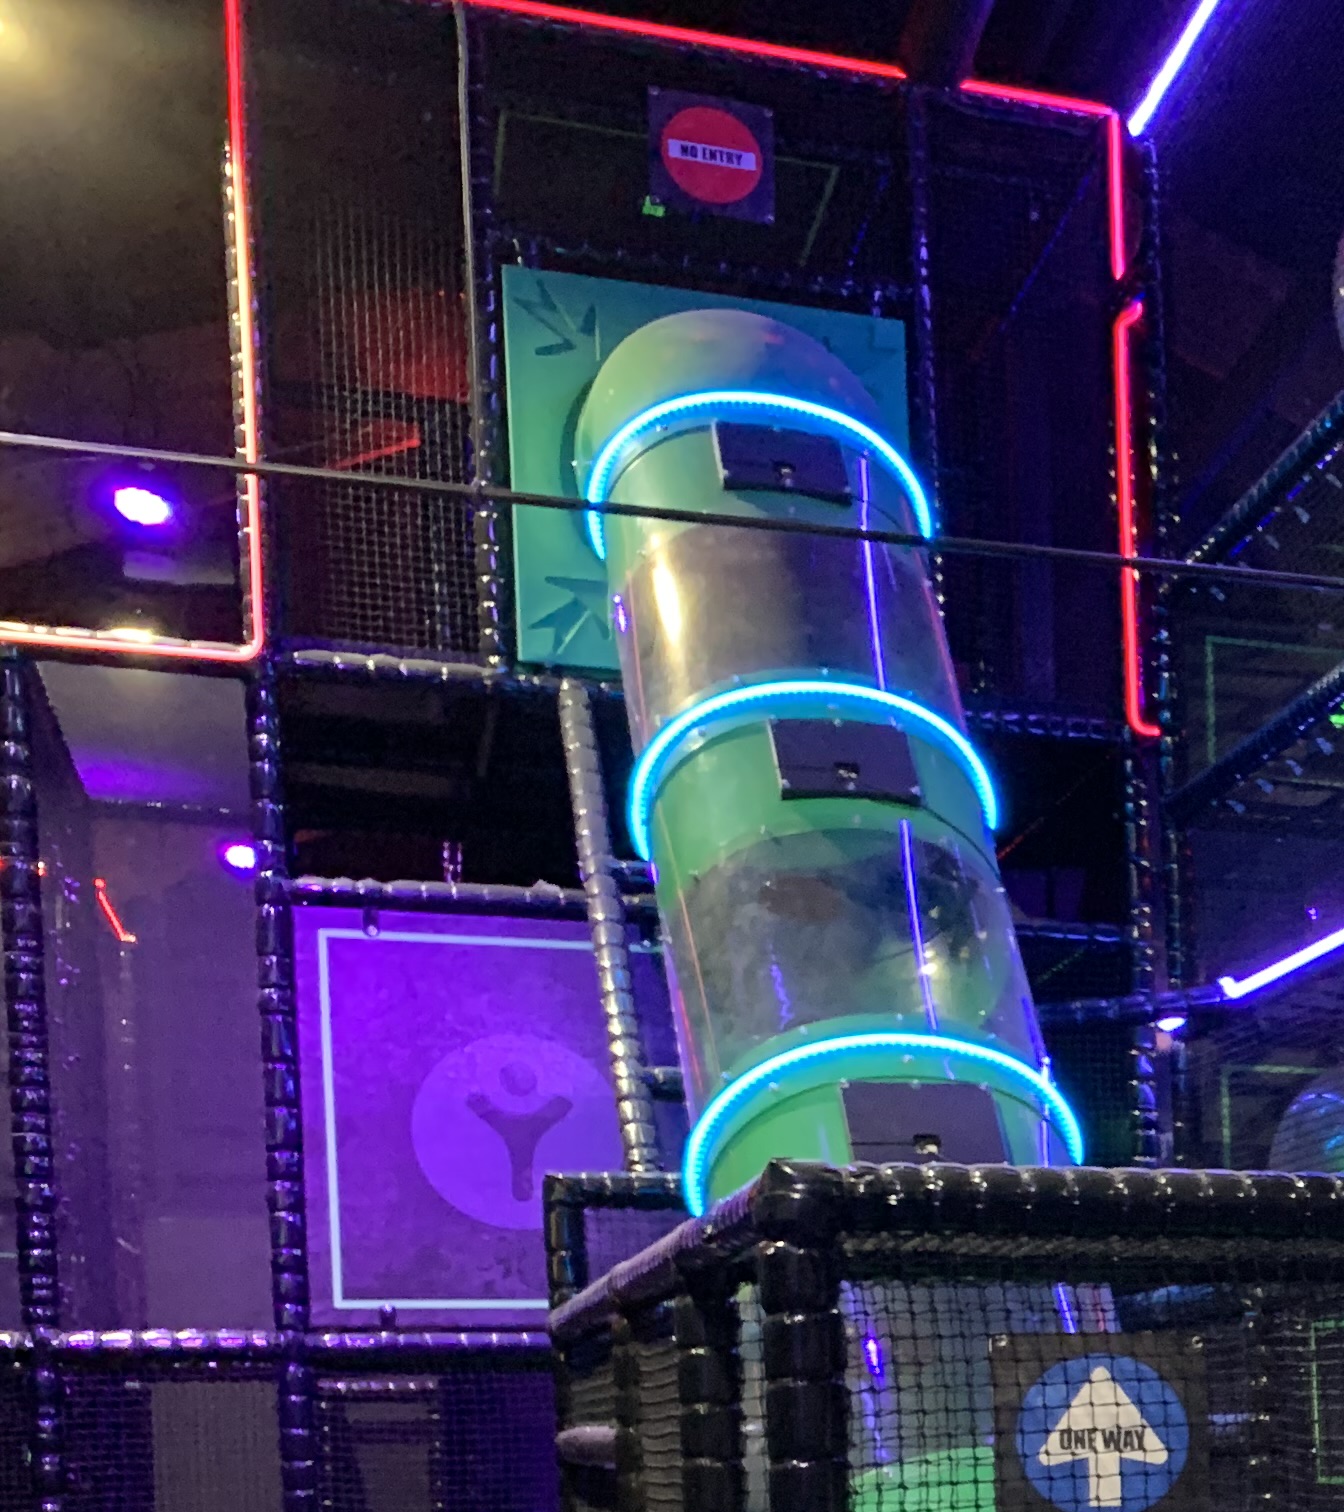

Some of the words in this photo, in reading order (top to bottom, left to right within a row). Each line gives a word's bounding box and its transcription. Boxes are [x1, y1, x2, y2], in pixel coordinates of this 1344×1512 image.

[680, 143, 699, 159] NO
[702, 147, 743, 166] ENTRY
[1059, 1428, 1098, 1451] ONE
[1101, 1427, 1145, 1452] WAY
